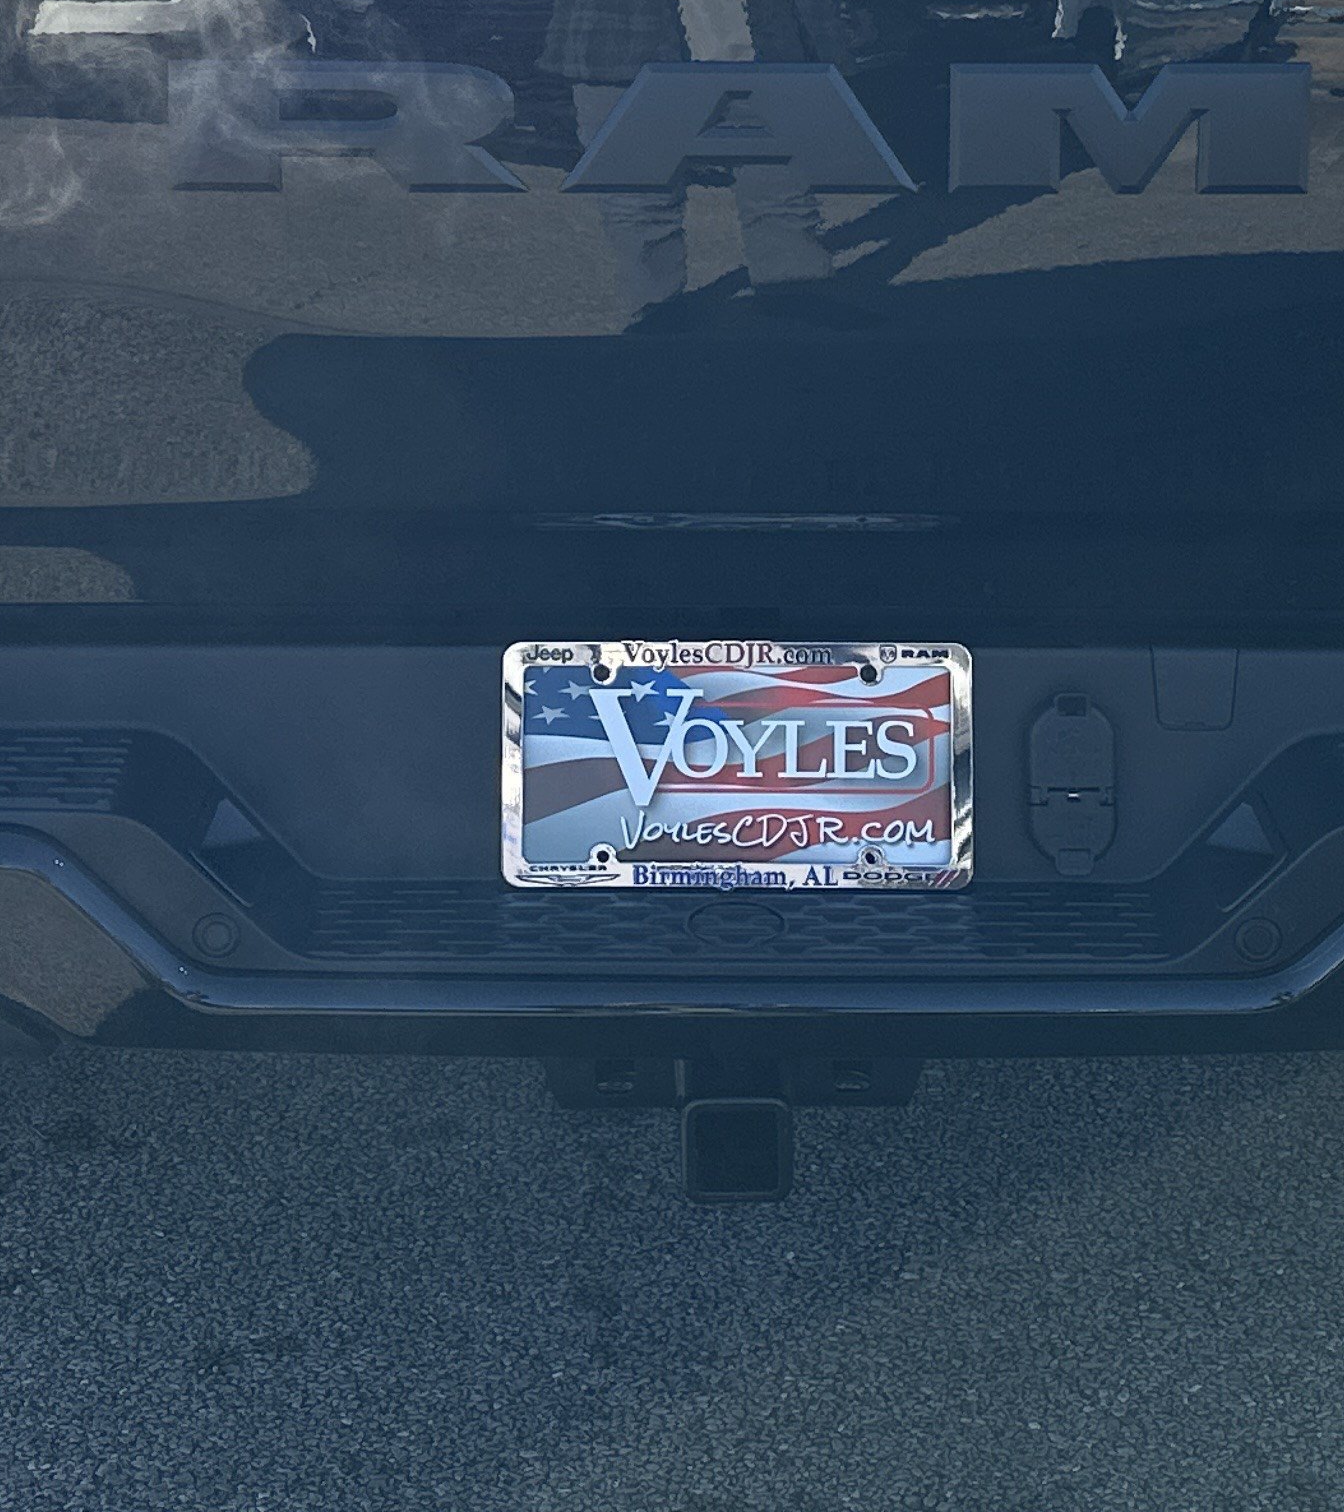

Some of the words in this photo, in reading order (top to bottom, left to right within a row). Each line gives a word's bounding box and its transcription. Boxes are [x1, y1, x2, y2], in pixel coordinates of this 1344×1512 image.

[169, 61, 1313, 194] RAM
[526, 646, 574, 664] Jeep
[623, 641, 831, 669] VoylesCDJR.com
[901, 650, 949, 658] RAM
[589, 688, 917, 806] VOYLES
[632, 865, 794, 891] Birmingham,
[802, 866, 838, 886] AL
